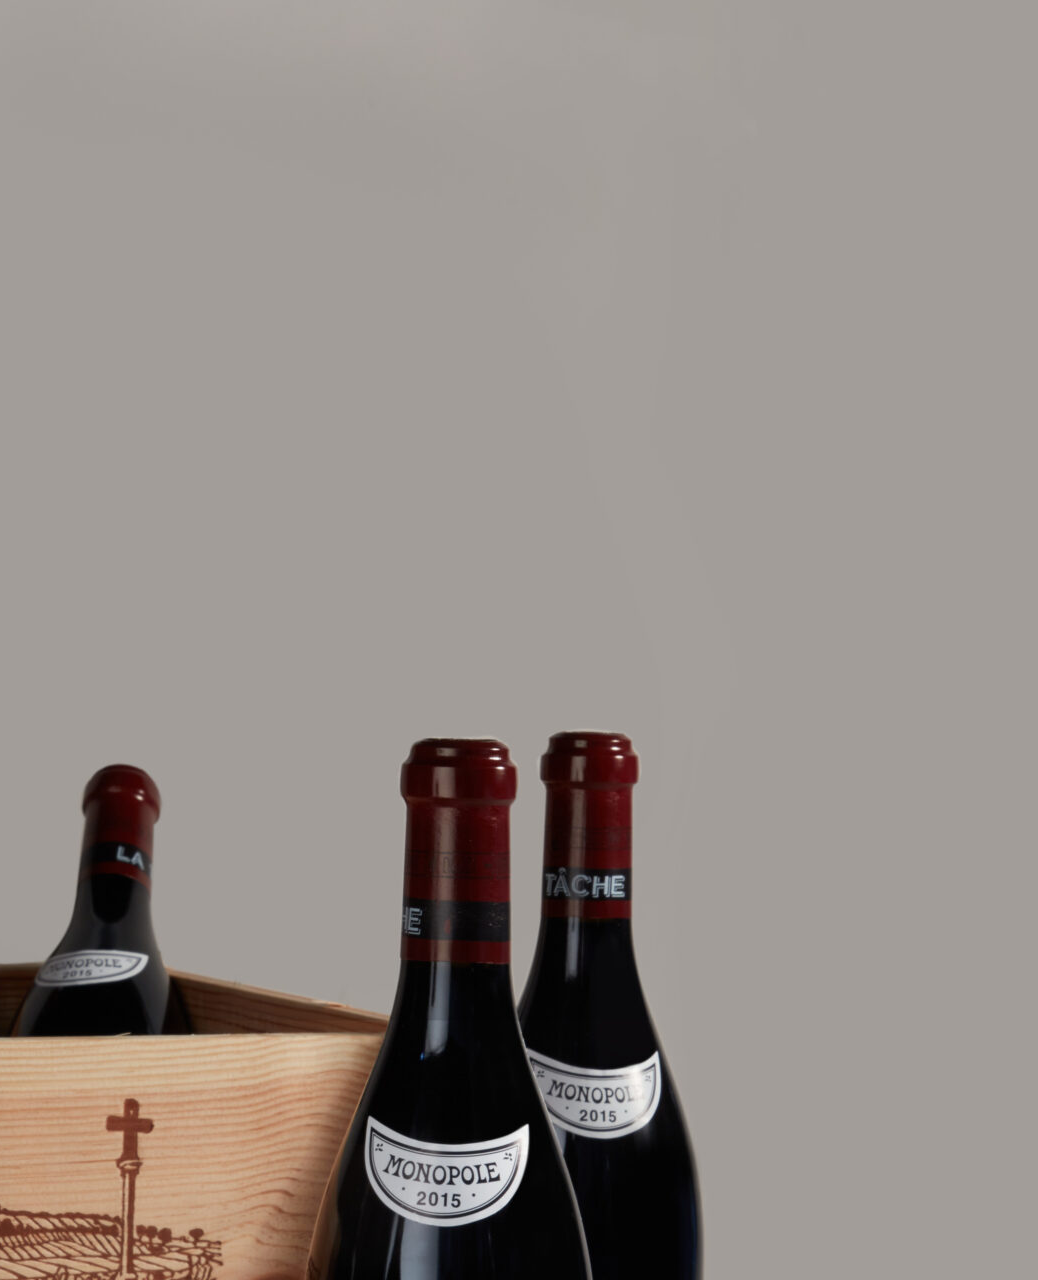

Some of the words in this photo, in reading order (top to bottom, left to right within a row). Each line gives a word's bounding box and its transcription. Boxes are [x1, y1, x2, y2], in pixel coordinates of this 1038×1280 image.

[116, 845, 145, 871] LA
[545, 867, 626, 899] TÂCHE
[62, 969, 92, 979] 2015
[547, 1079, 643, 1104] MONOPOL
[579, 1109, 617, 1123] 2015
[383, 1154, 501, 1186] MONOPOLE
[416, 1190, 461, 1208] 2015
